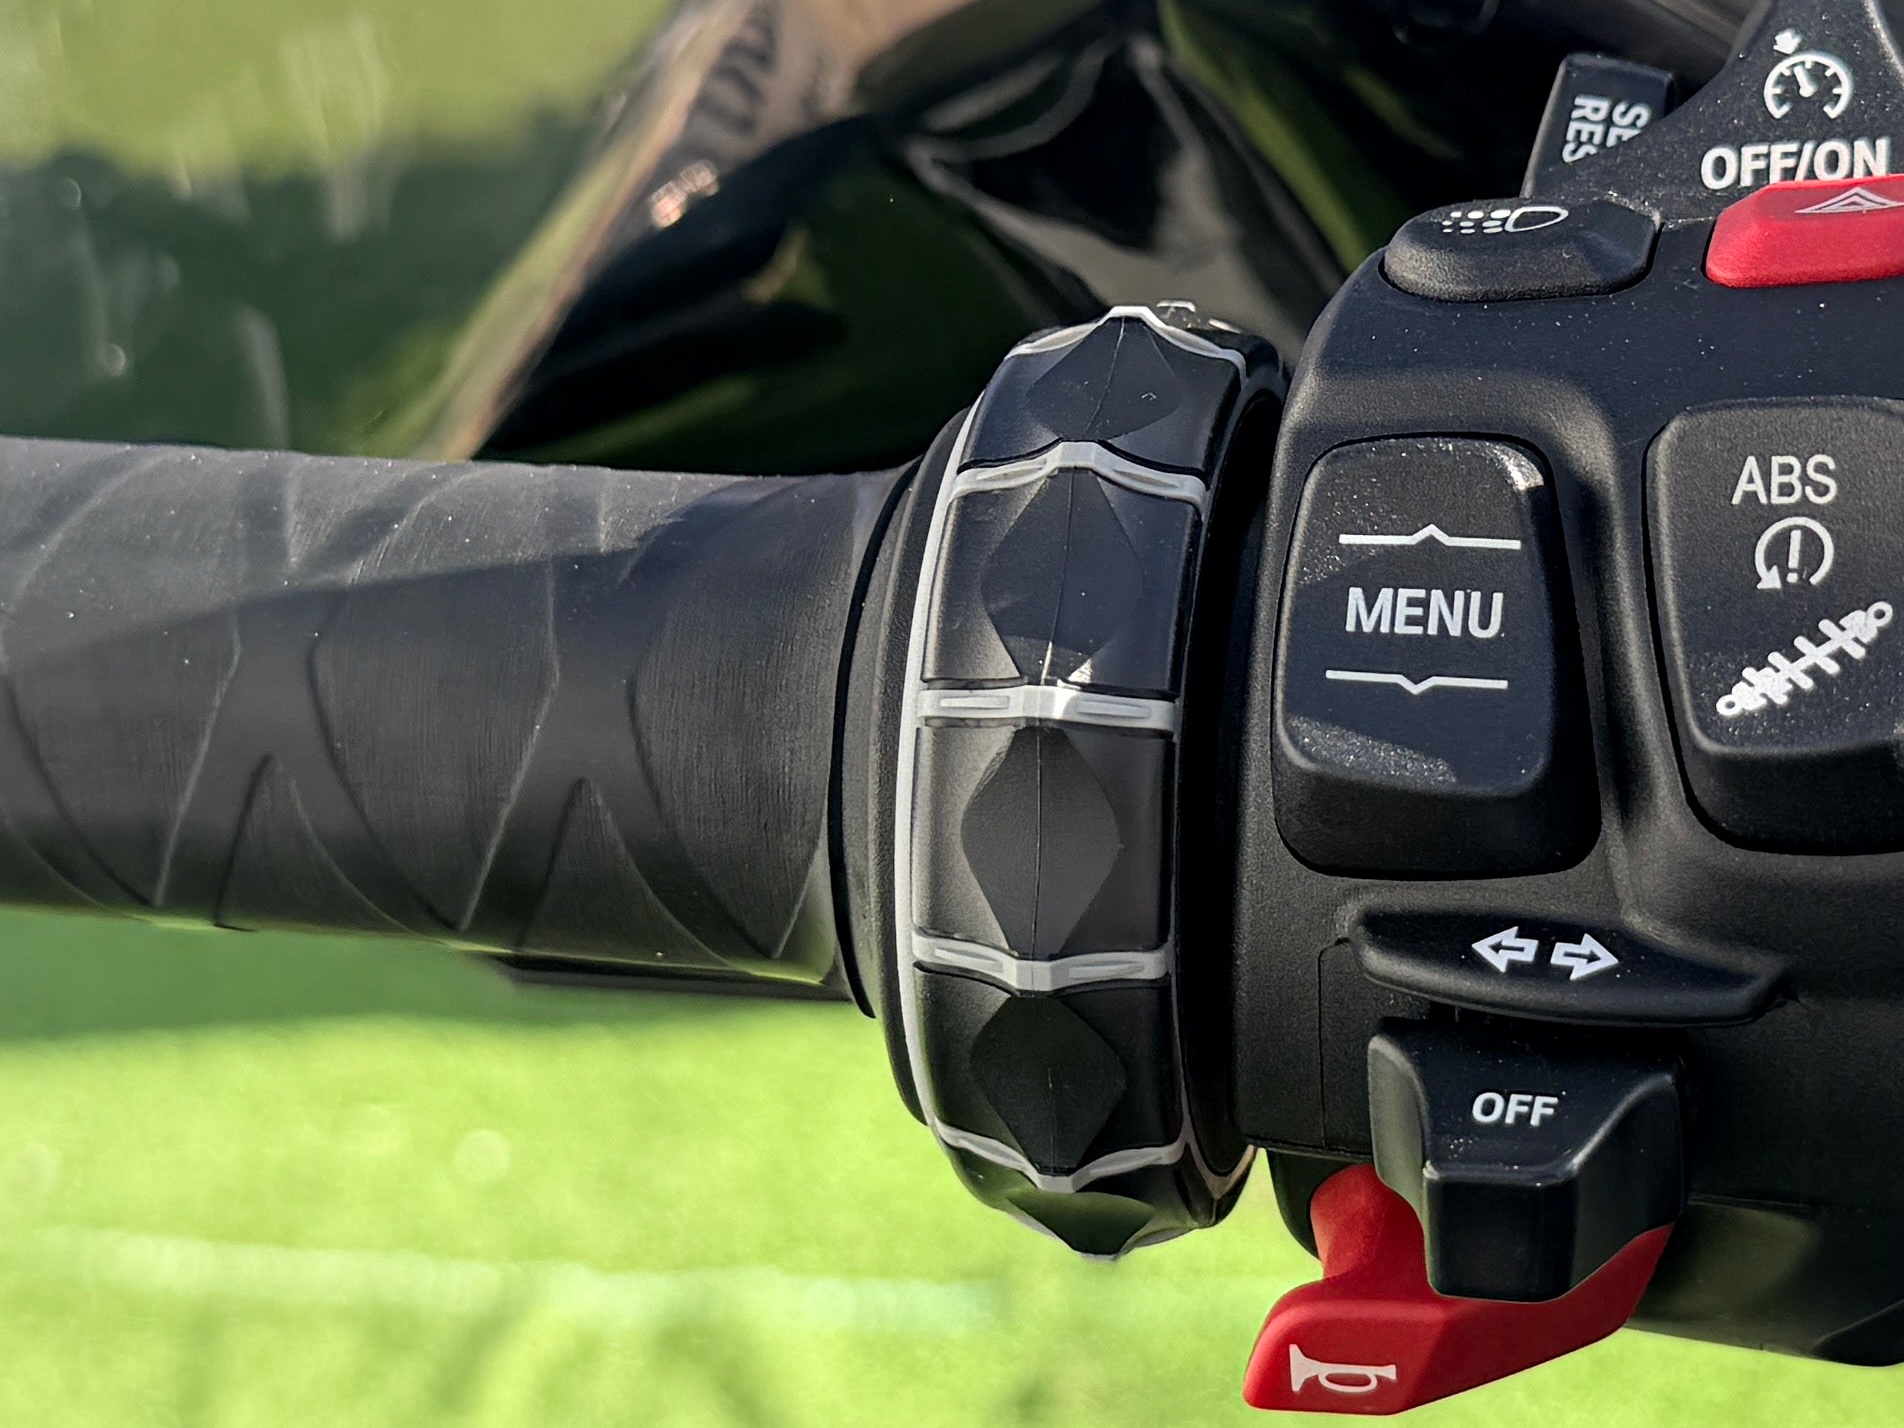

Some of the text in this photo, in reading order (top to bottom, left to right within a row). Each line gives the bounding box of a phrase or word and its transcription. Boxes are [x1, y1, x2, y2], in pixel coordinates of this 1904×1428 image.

[1561, 94, 1611, 163] RES
[1605, 100, 1652, 148] SE
[1700, 136, 1890, 190] OFF/ON
[1731, 454, 1839, 506] ABS
[1344, 586, 1504, 639] MENU
[1471, 1091, 1559, 1127] OFF
